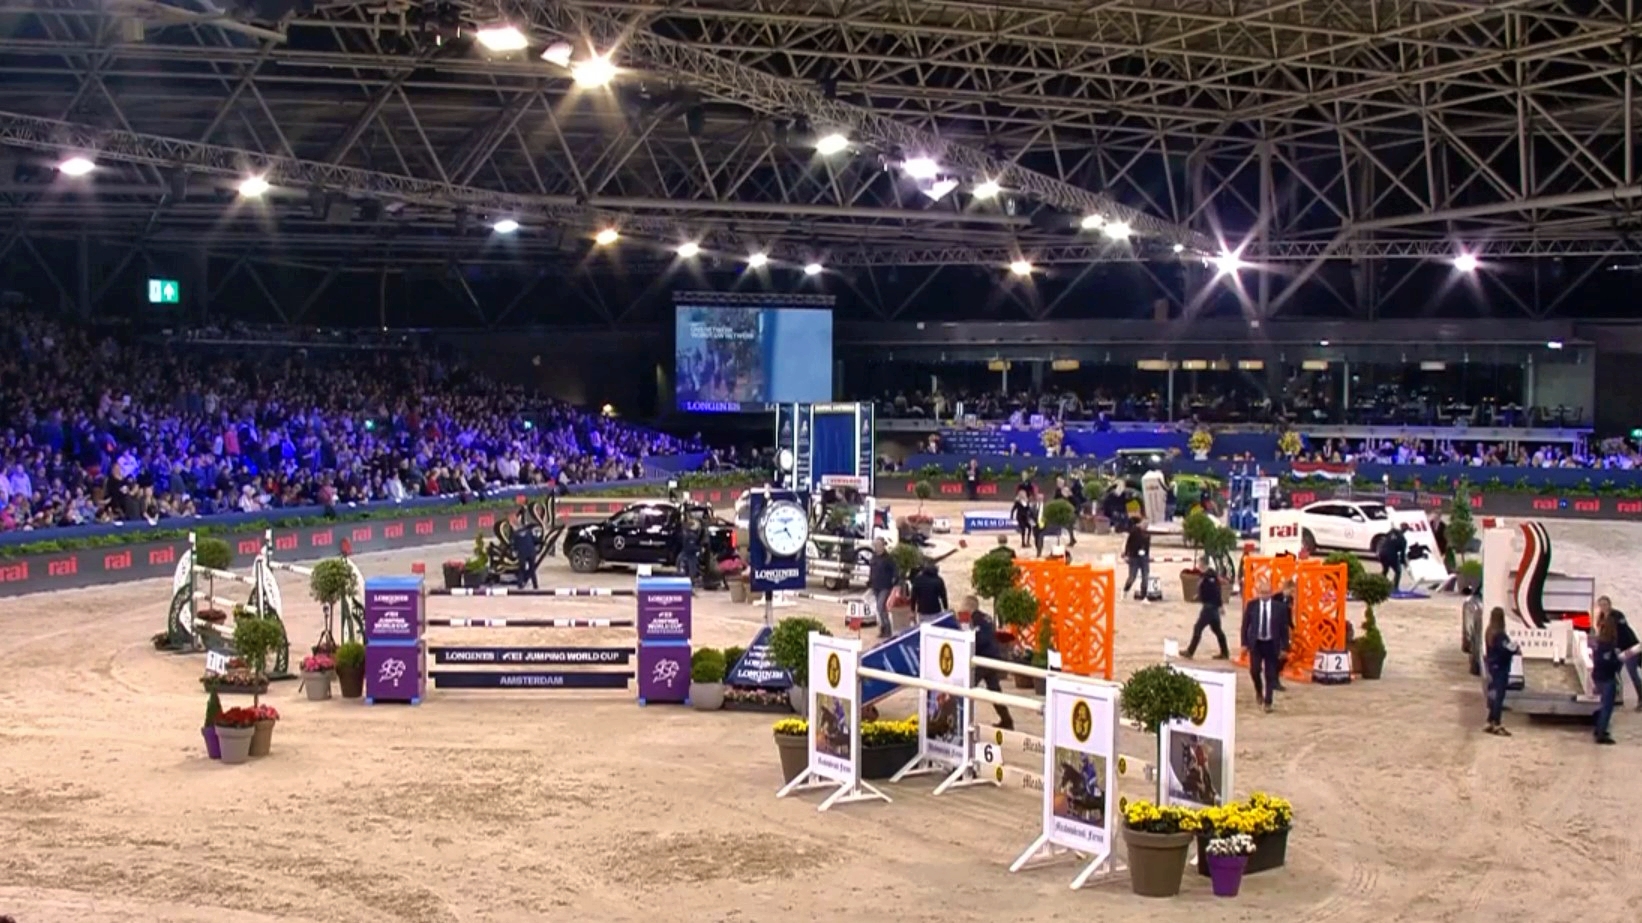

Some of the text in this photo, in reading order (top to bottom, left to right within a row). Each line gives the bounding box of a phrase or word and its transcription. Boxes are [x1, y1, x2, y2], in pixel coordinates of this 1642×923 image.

[687, 402, 741, 411] LONGINES
[1533, 497, 1559, 510] rai
[1574, 498, 1600, 512] rai
[1617, 500, 1642, 513] rai
[415, 519, 434, 535] rai
[450, 516, 468, 531] rai
[478, 512, 495, 527] rai
[312, 529, 333, 546] rai
[352, 526, 373, 542] rai
[384, 522, 404, 539] rai
[1269, 523, 1299, 538] rai
[275, 533, 299, 550] rai
[104, 550, 132, 570] rai
[149, 546, 175, 565] rai
[48, 555, 78, 576] rai
[755, 568, 800, 580] LONGINES
[446, 652, 494, 661] LONGINES
[525, 652, 566, 661] JUMPING
[567, 652, 600, 661] WORLD
[600, 652, 619, 661] CUP
[1335, 655, 1342, 670] 2
[499, 676, 564, 685] AMSTERDAM
[984, 744, 994, 763] 6
